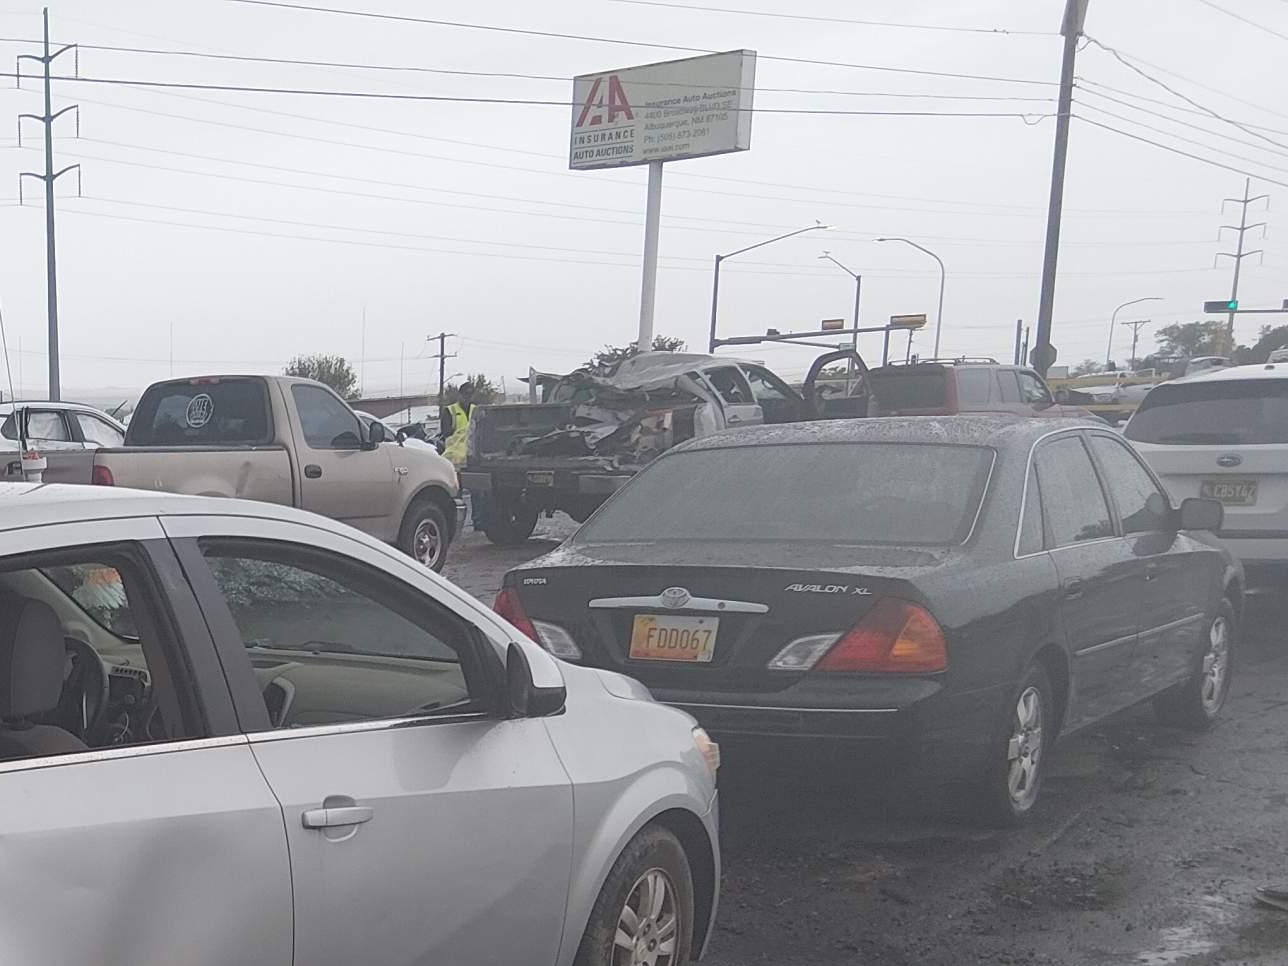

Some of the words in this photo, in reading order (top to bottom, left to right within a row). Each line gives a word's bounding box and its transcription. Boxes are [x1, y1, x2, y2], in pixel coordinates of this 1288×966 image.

[683, 95, 700, 103] Auto
[574, 129, 634, 144] INSURANCE
[574, 150, 594, 160] AUTO
[595, 144, 634, 157] AUCTIONS
[784, 583, 849, 593] AVALON
[851, 587, 873, 595] XL
